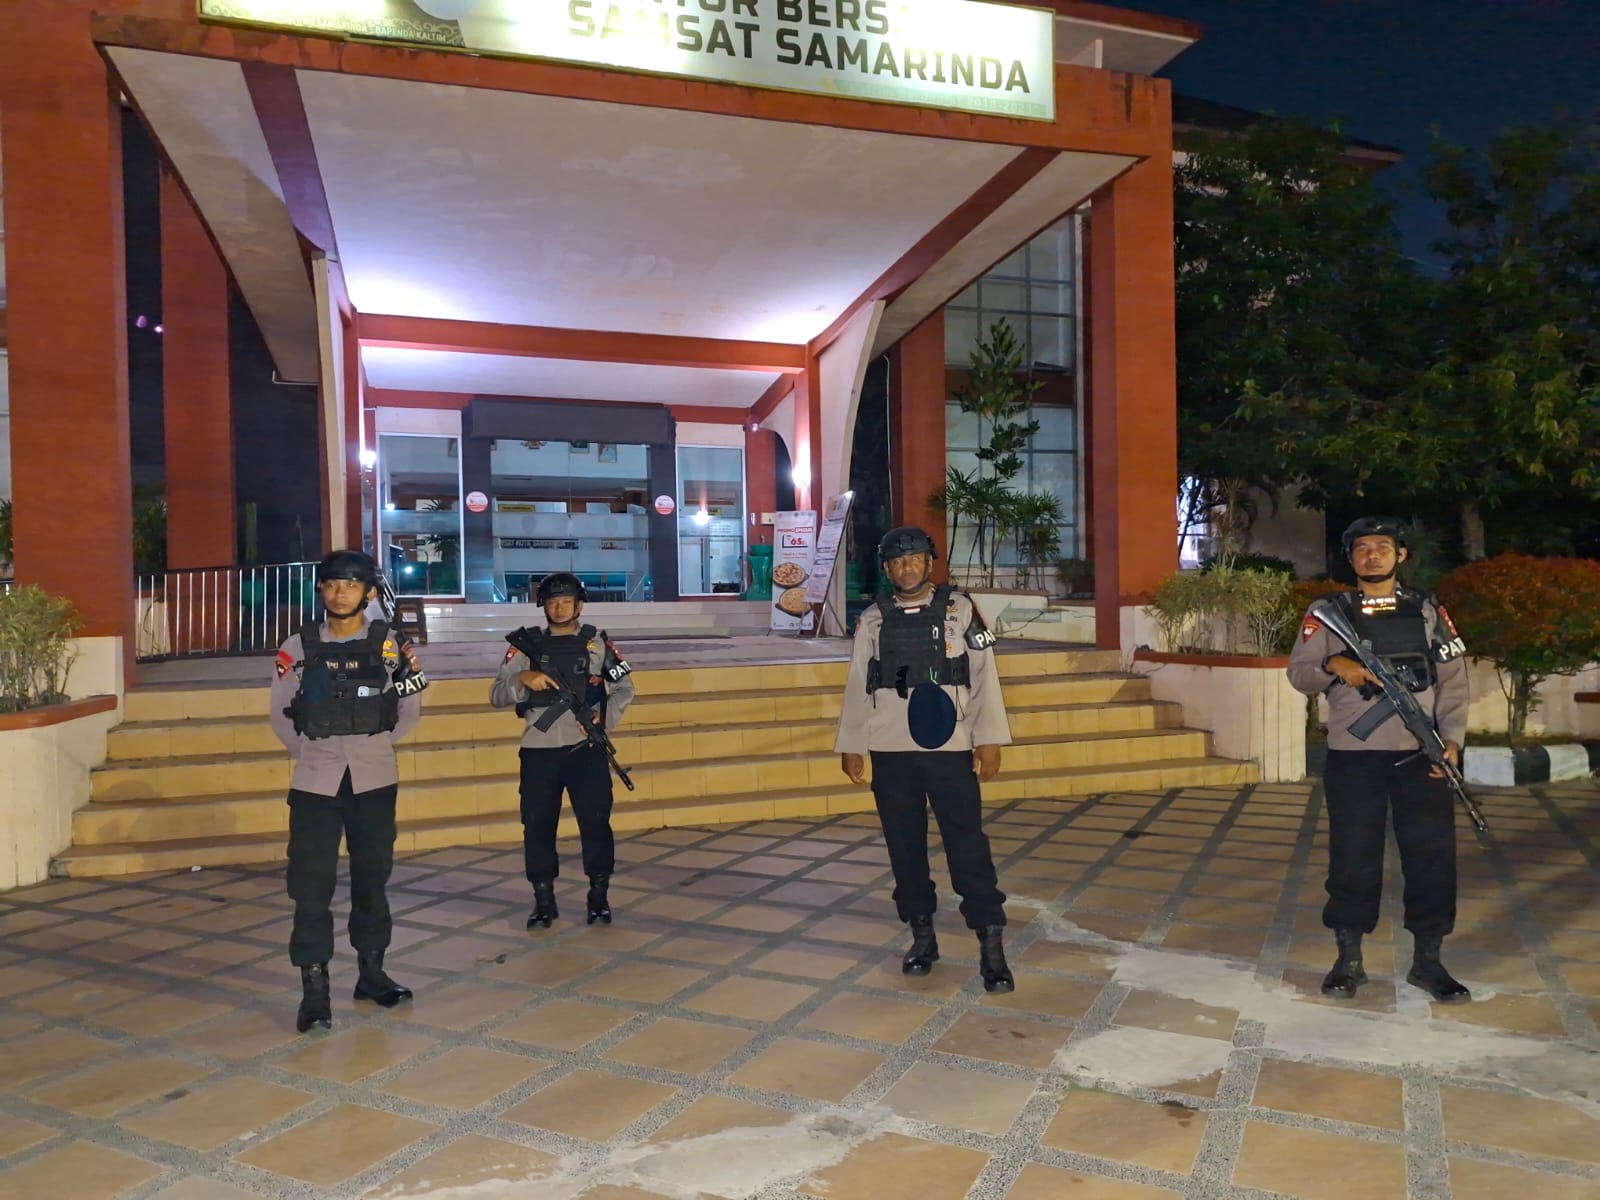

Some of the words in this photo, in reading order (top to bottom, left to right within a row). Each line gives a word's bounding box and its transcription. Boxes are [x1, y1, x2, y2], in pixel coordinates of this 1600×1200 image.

[416, 31, 447, 42] KALTIM
[568, 0, 760, 58] SASAT
[776, 27, 1031, 93] SAMARINDA
